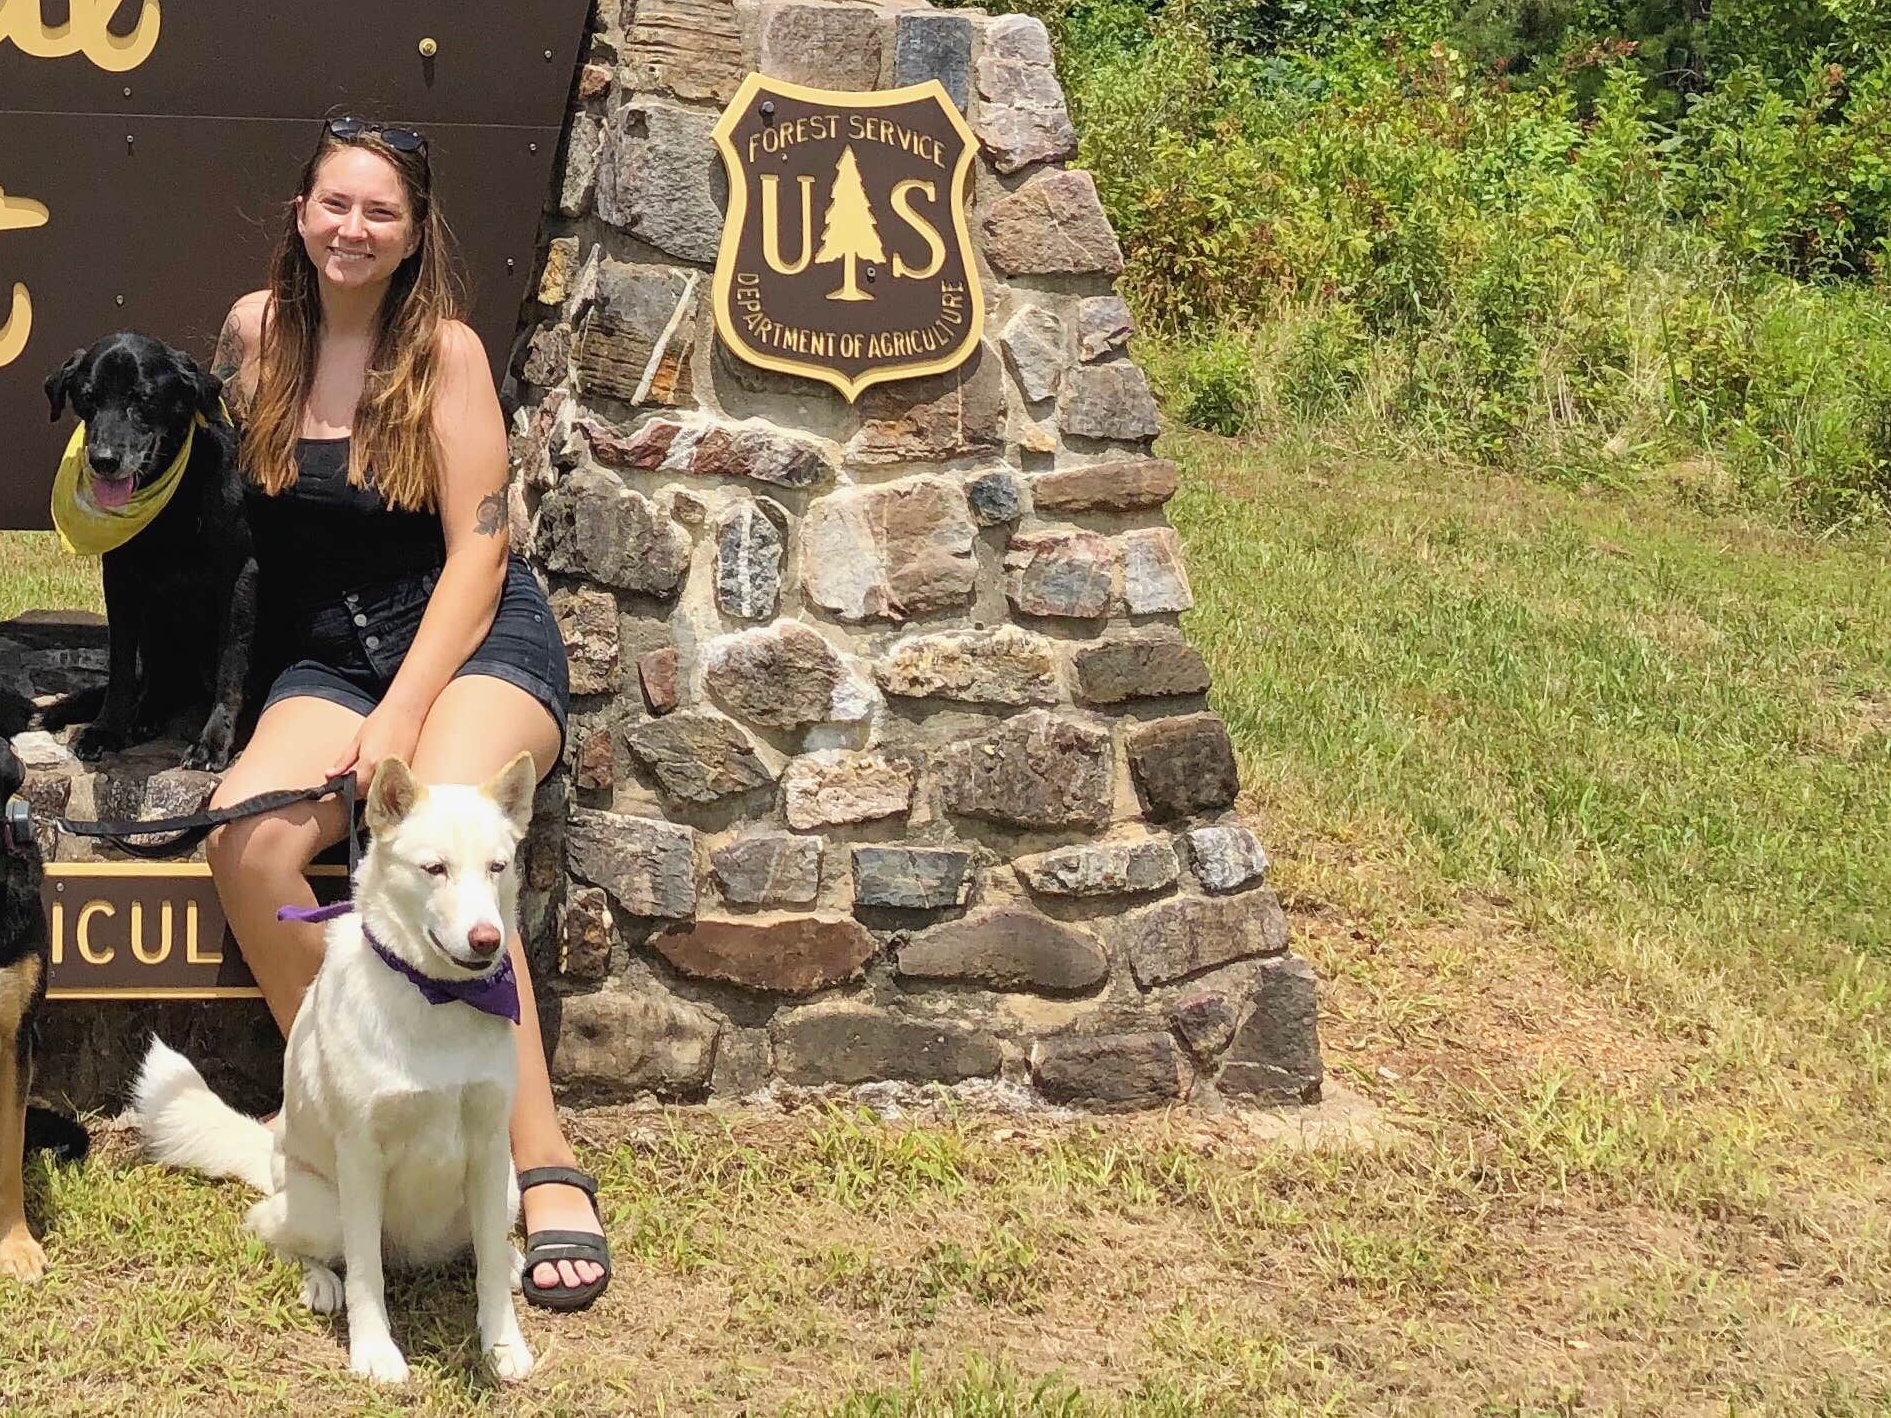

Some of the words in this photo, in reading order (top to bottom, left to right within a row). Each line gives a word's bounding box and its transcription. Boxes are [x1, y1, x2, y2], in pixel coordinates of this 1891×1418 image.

[748, 115, 841, 164] FOREST
[847, 114, 946, 170] SERVICE
[736, 272, 837, 357] DEPARTMENT
[839, 333, 865, 359] OF
[867, 279, 965, 359] AGRICULTURE
